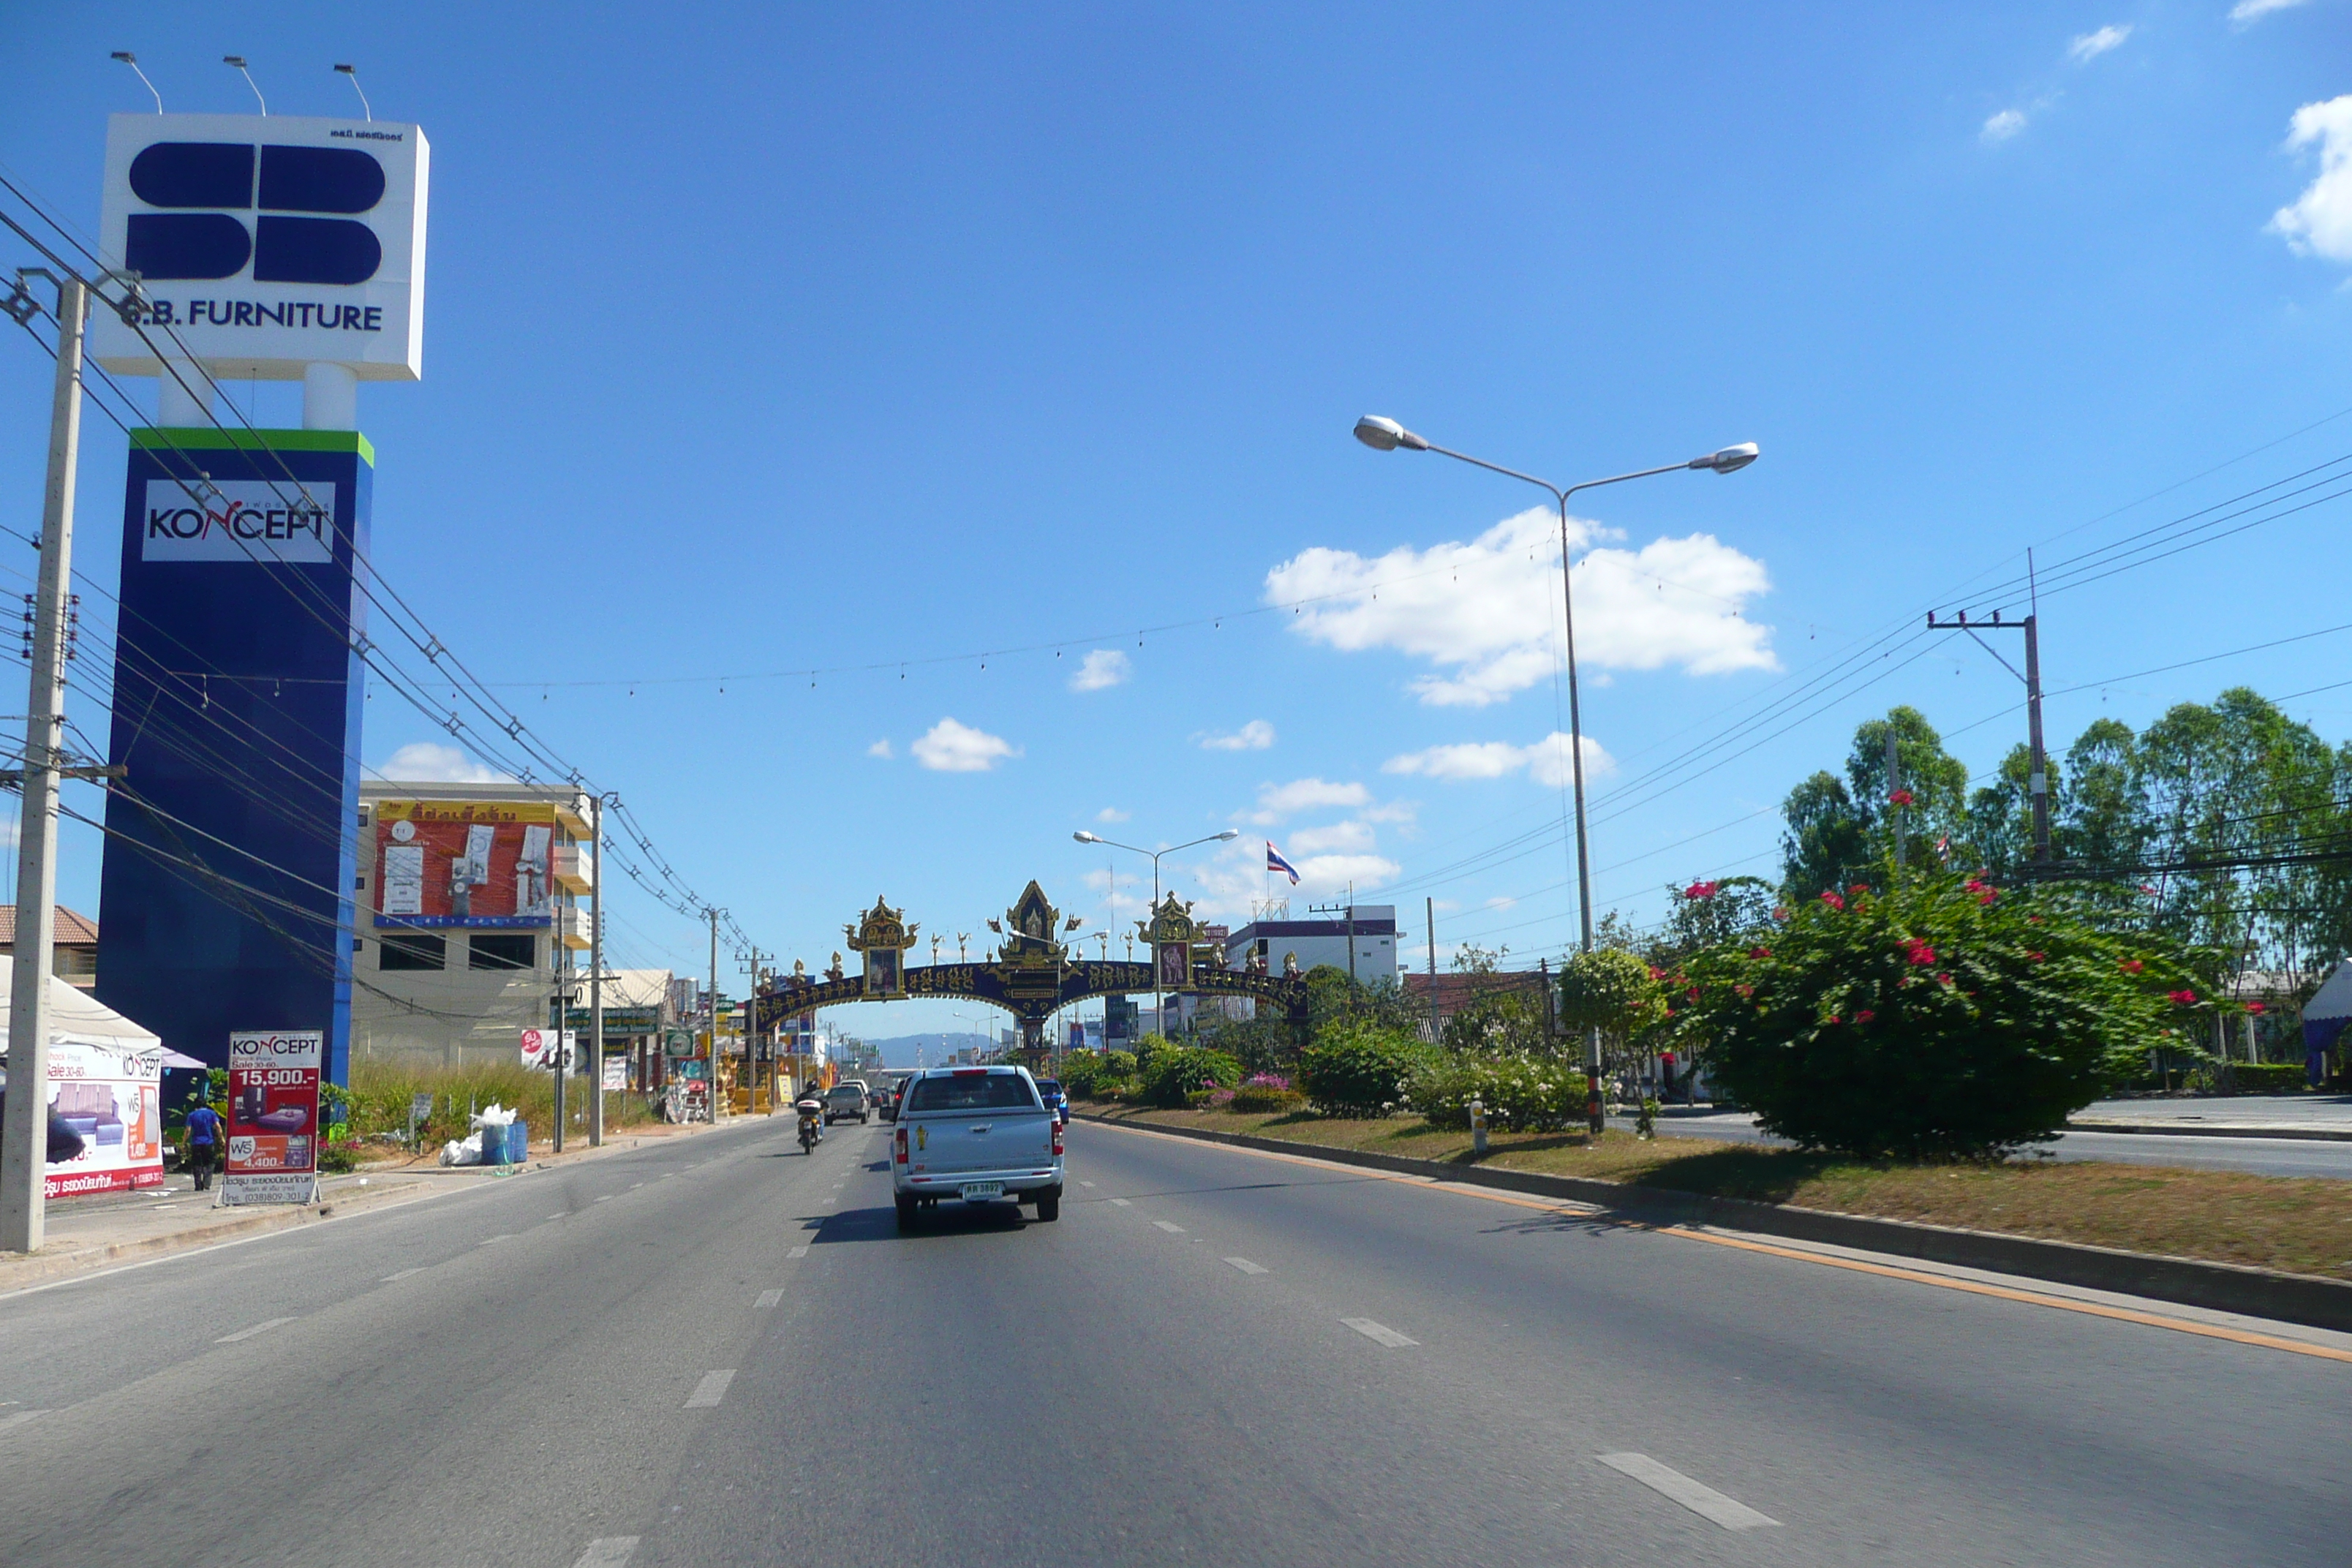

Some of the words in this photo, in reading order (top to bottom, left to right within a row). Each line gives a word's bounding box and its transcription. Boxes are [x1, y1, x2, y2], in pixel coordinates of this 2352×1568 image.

[189, 301, 382, 331] FURNITURE
[148, 500, 328, 540] KONCEPT
[233, 1036, 318, 1055] KONCEPT
[48, 1052, 65, 1061] hock
[238, 1070, 315, 1086] 15,900.-
[231, 1140, 252, 1154] ฟรี
[244, 1157, 284, 1168] 4,400.-
